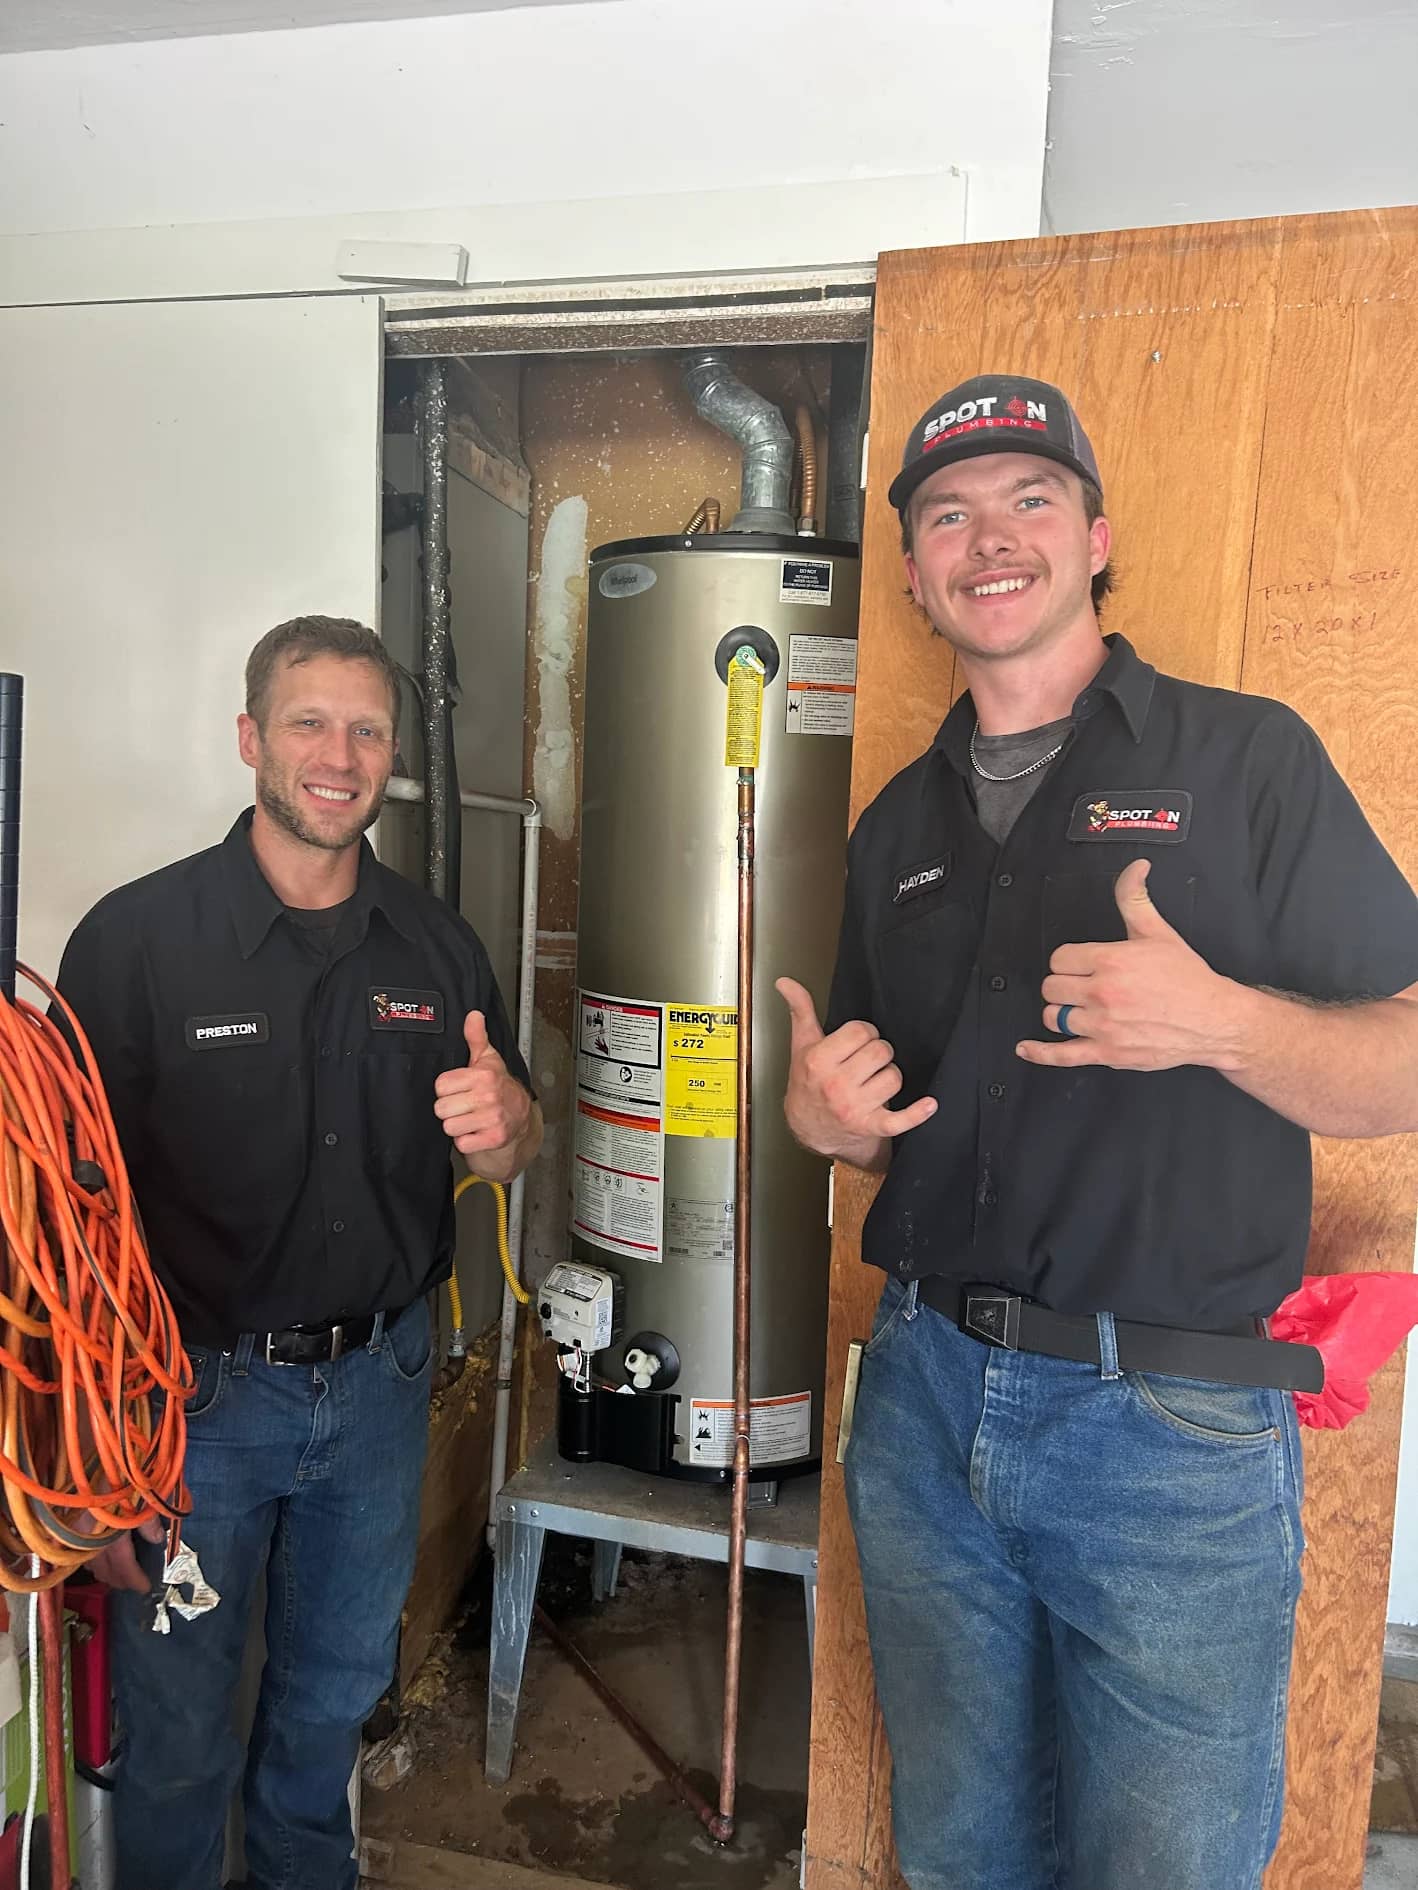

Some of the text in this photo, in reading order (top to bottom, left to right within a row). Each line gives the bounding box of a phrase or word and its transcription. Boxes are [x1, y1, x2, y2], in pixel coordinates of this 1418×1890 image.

[923, 397, 997, 442] SPOT
[933, 419, 1032, 443] PLUMBING
[1256, 568, 1402, 600] FILTER SIZE
[1107, 809, 1152, 821] SPOT
[898, 864, 945, 893] HAYDEN
[390, 1002, 419, 1013] SPOT
[670, 1011, 738, 1026] ENERGYGUID
[196, 1023, 258, 1040] PRESTON
[681, 1038, 704, 1049] 272
[688, 1079, 705, 1088] 250
